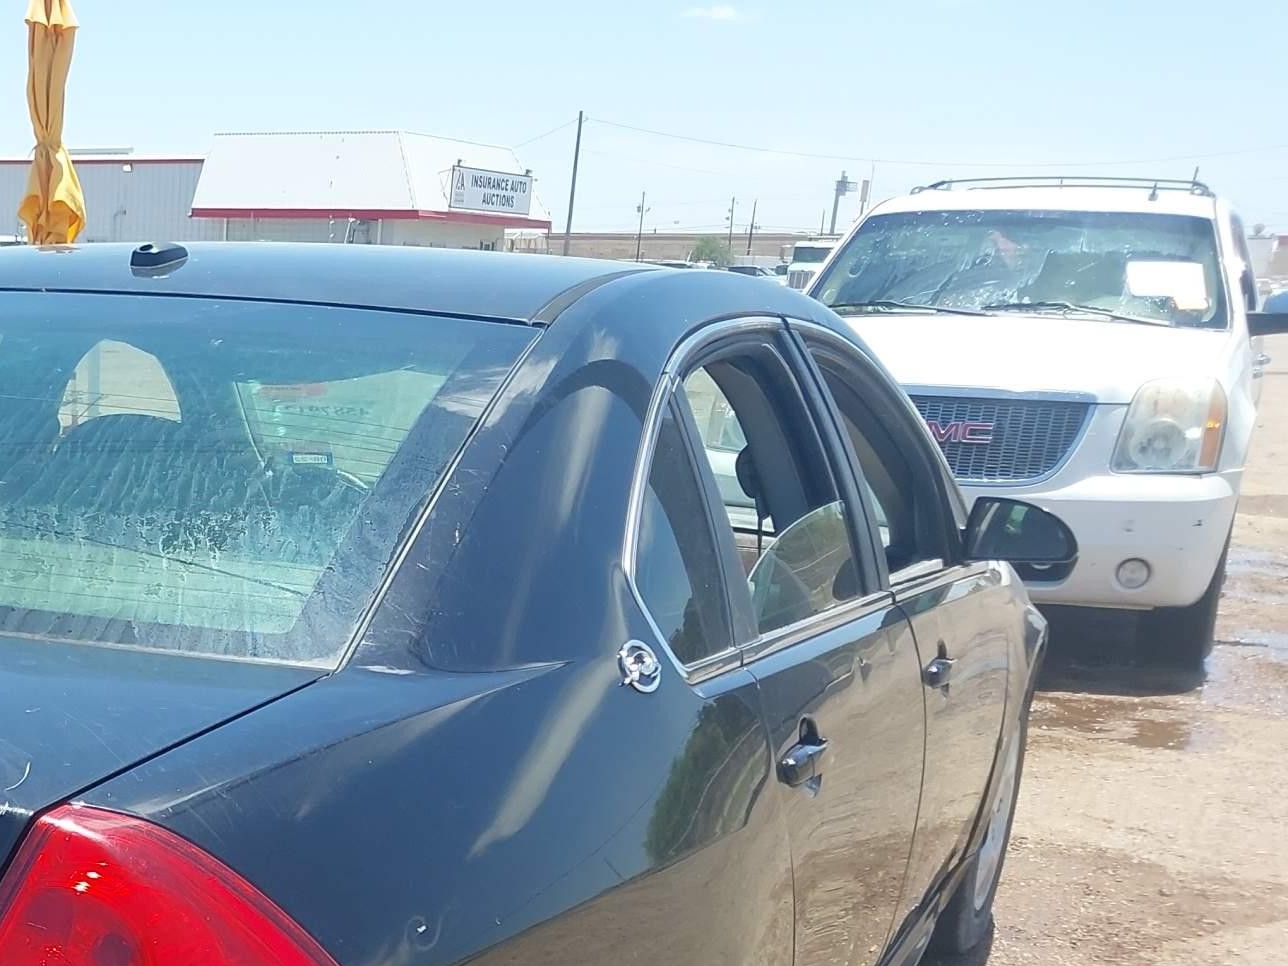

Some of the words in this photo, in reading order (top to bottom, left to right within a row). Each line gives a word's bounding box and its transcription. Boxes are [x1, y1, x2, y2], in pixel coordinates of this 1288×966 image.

[471, 174, 509, 191] INSURANCE
[510, 180, 527, 194] AUTO
[482, 192, 515, 208] AUCTIONS
[928, 421, 996, 443] MC
